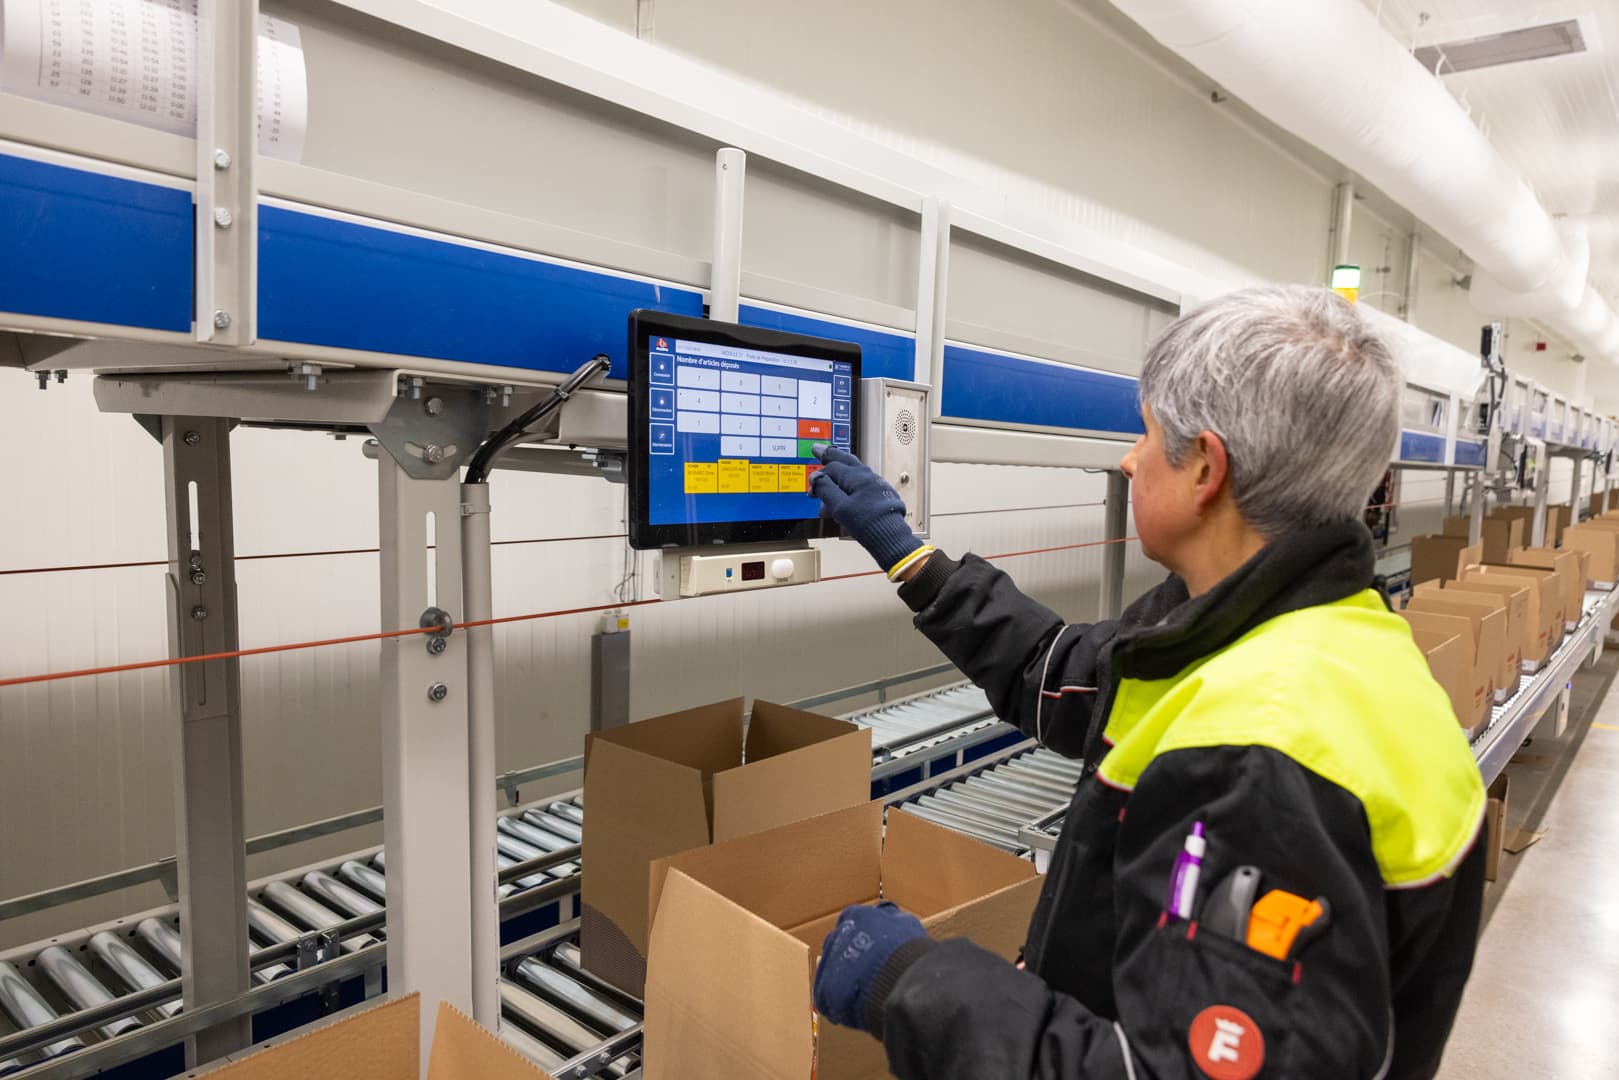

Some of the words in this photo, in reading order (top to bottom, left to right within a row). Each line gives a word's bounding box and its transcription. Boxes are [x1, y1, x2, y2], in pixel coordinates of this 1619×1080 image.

[676, 356, 697, 364] Nombre
[698, 358, 720, 367] d'articles
[720, 360, 740, 369] déposés
